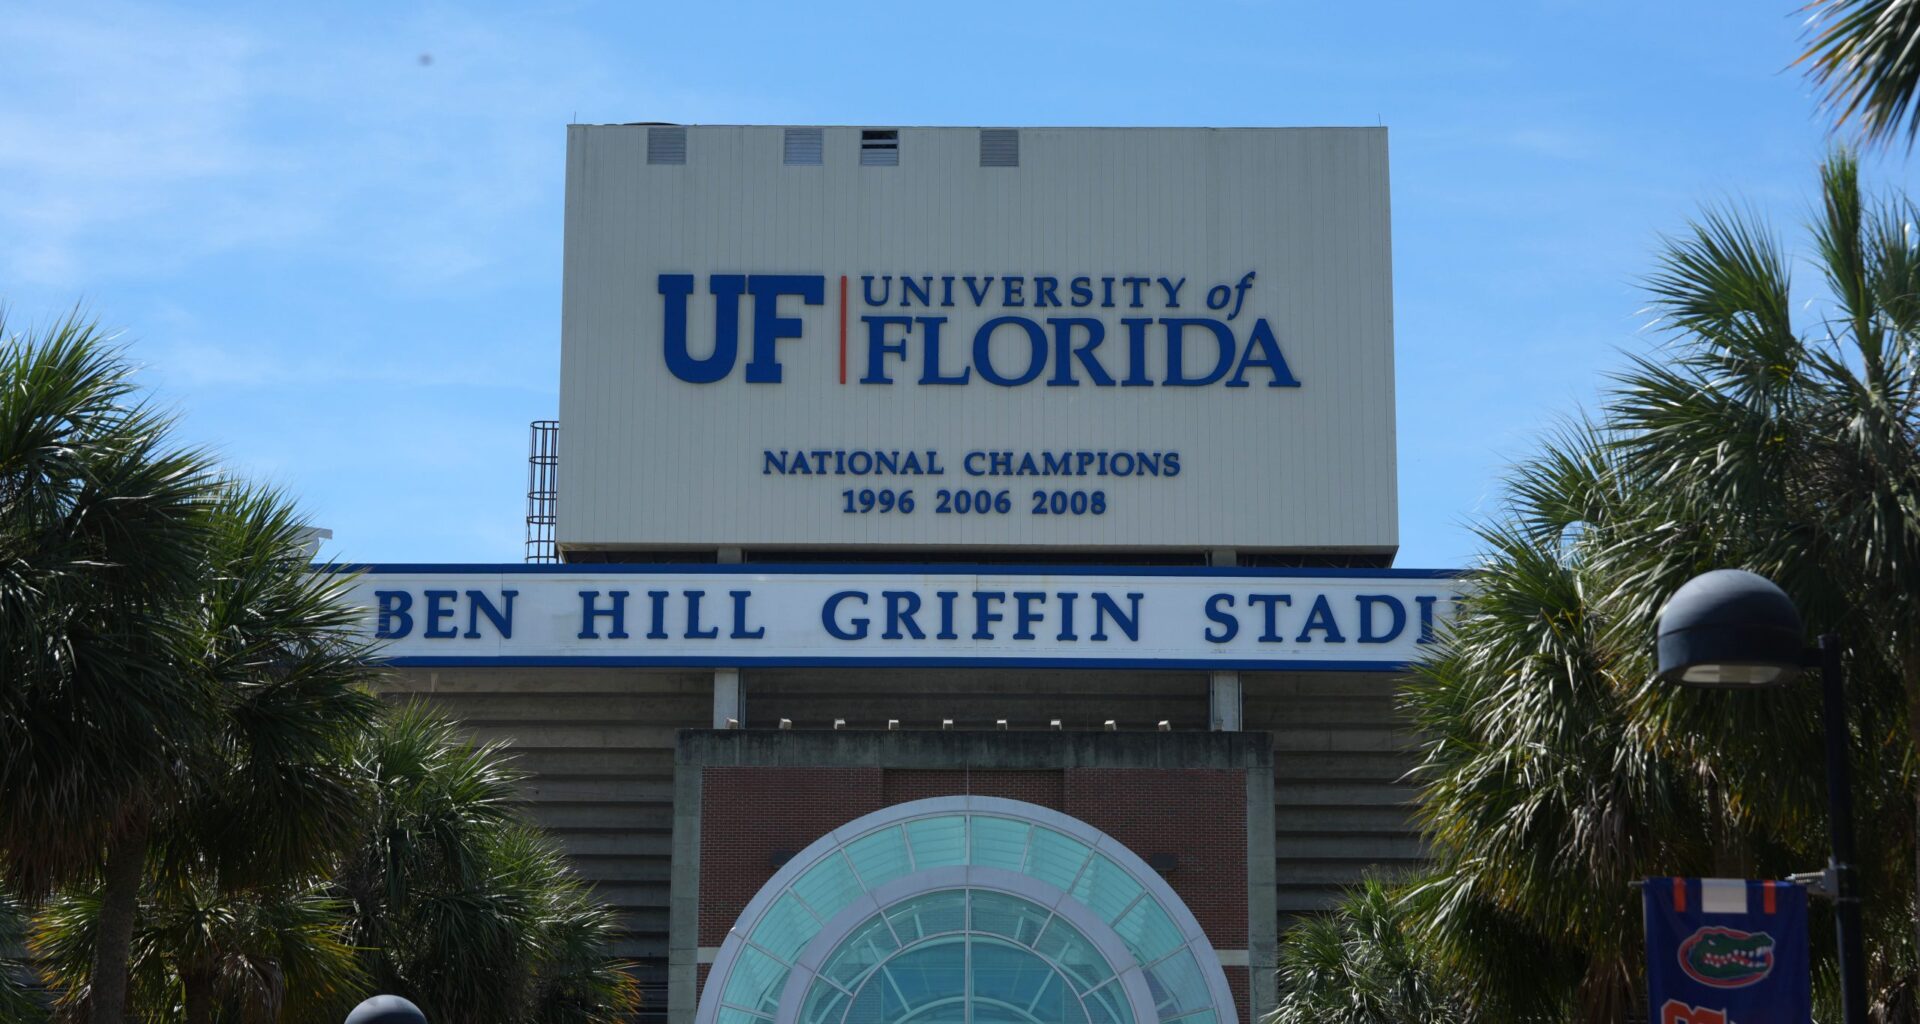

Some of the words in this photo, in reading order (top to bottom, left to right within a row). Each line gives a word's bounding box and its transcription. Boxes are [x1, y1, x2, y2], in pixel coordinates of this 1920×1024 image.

[861, 273, 1187, 309] UNIVERSITY
[1206, 271, 1257, 321] of
[657, 272, 826, 384] UF
[859, 316, 1302, 389] FLORIDA
[762, 449, 945, 477] NATIONAL
[963, 450, 1182, 478] CHAMPIONS
[841, 488, 916, 515] 1996
[935, 489, 1013, 516] 2006
[1031, 490, 1108, 517] 2008
[374, 589, 520, 640] BEN
[577, 590, 767, 640] HILL
[821, 590, 1145, 642] GRIFFIN
[1204, 593, 1467, 645] STADI
